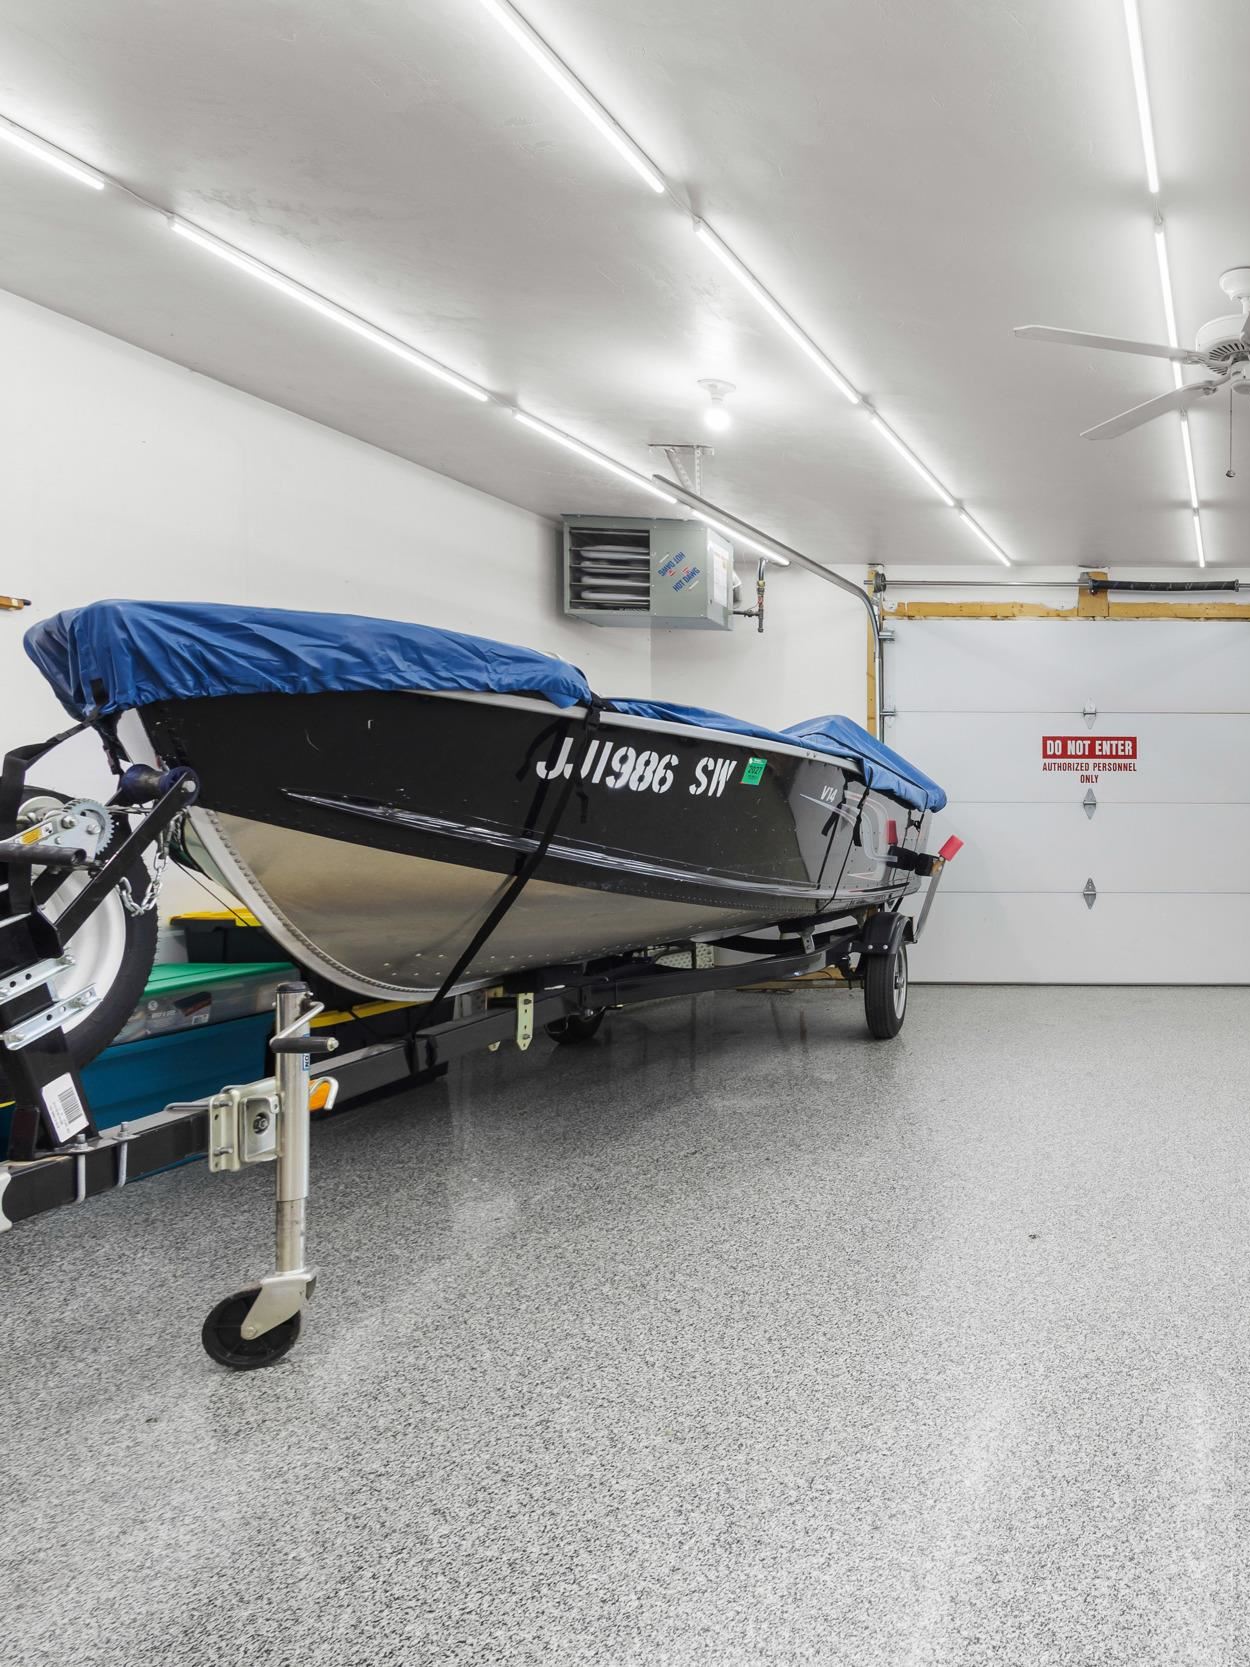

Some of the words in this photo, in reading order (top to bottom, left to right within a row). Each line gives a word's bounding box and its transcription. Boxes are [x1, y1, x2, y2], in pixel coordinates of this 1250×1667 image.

[1046, 740, 1062, 755] DO
[1067, 740, 1091, 755] NOT
[1095, 740, 1133, 755] ENTER
[1042, 762, 1090, 772] AUTHORIZED
[1093, 762, 1137, 772] PERSONNEL
[689, 757, 738, 797] SW
[1080, 774, 1099, 784] ONLY
